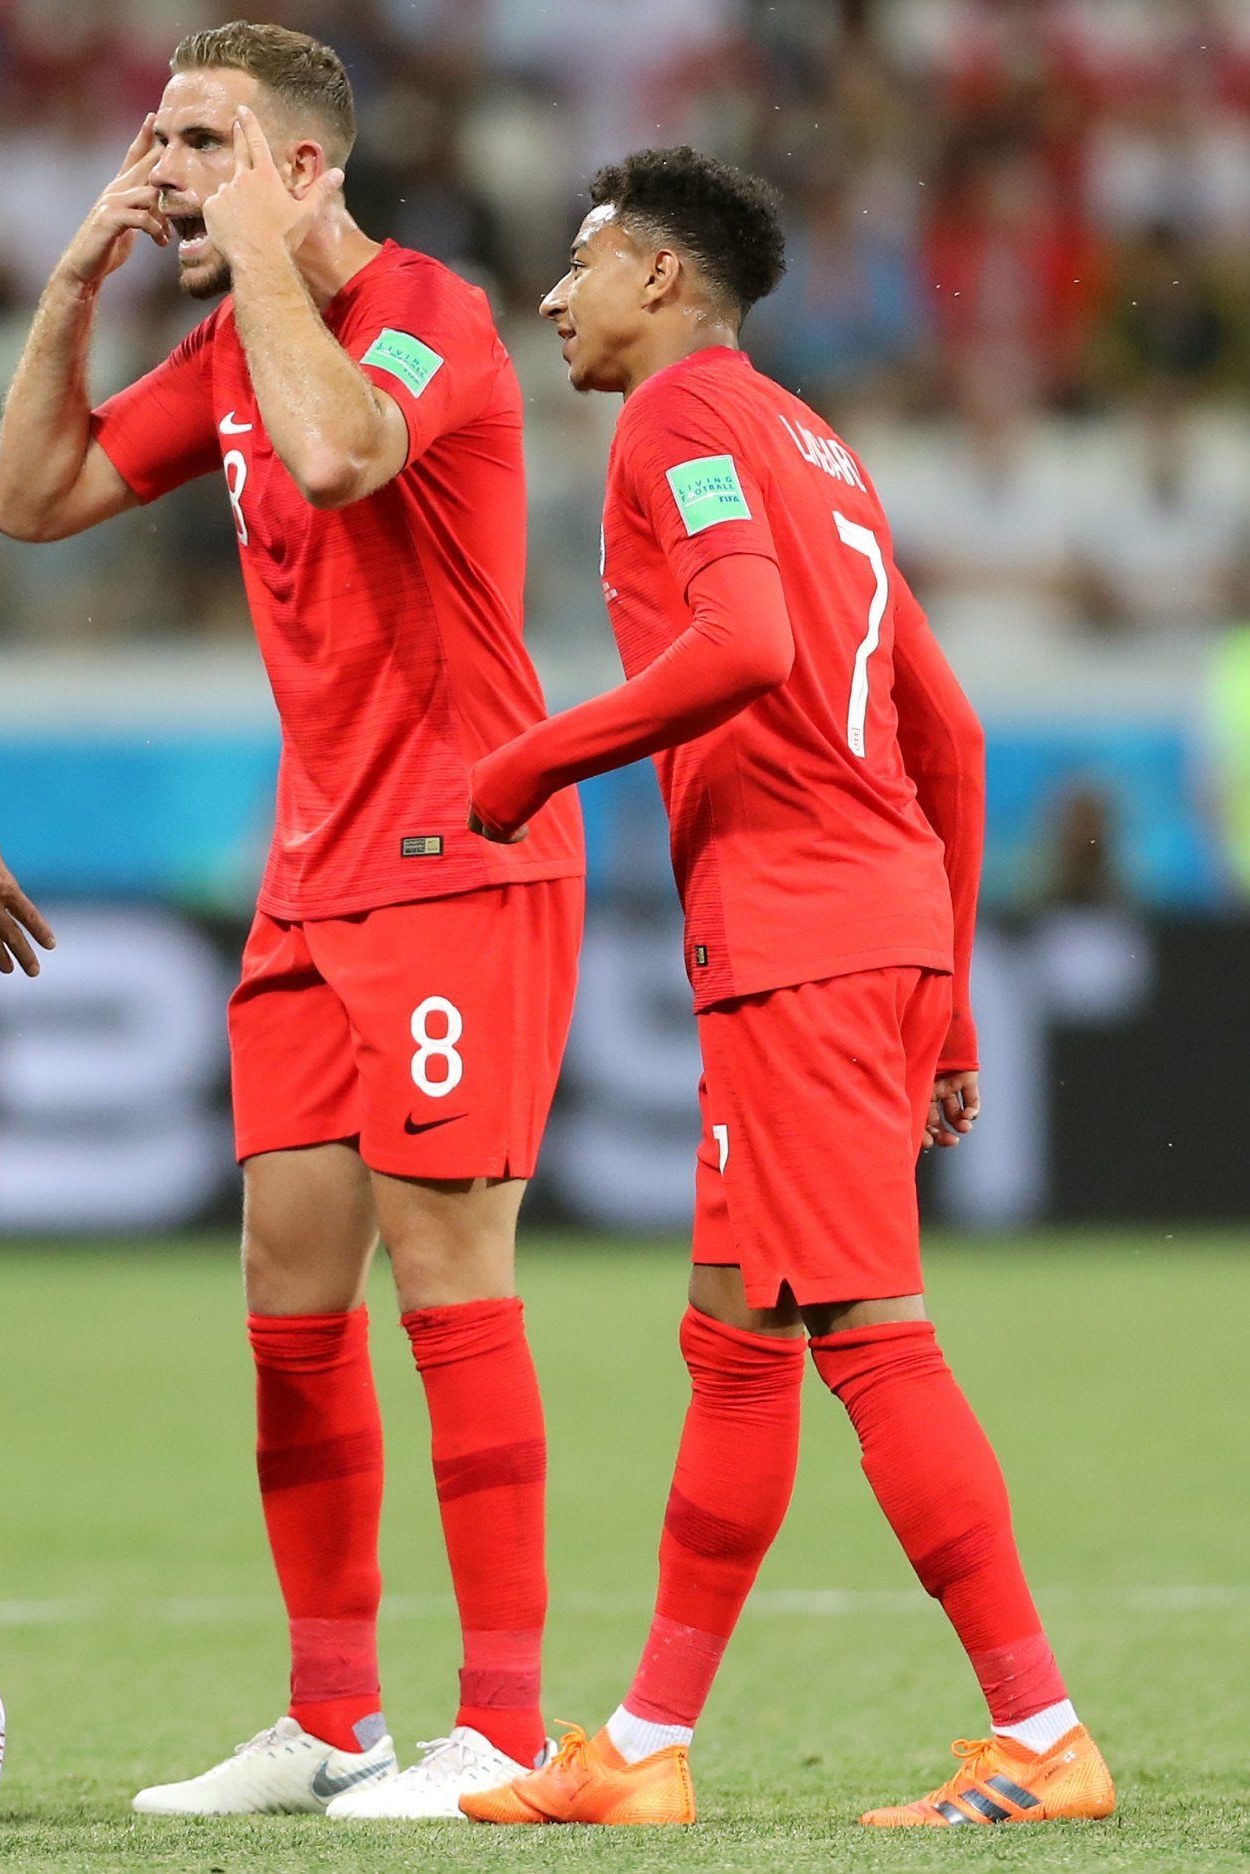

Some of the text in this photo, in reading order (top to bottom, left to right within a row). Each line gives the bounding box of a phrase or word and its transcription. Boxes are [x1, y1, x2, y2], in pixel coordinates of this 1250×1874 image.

[679, 475, 733, 494] LIVING
[832, 510, 889, 758] 7
[410, 995, 464, 1098] 8
